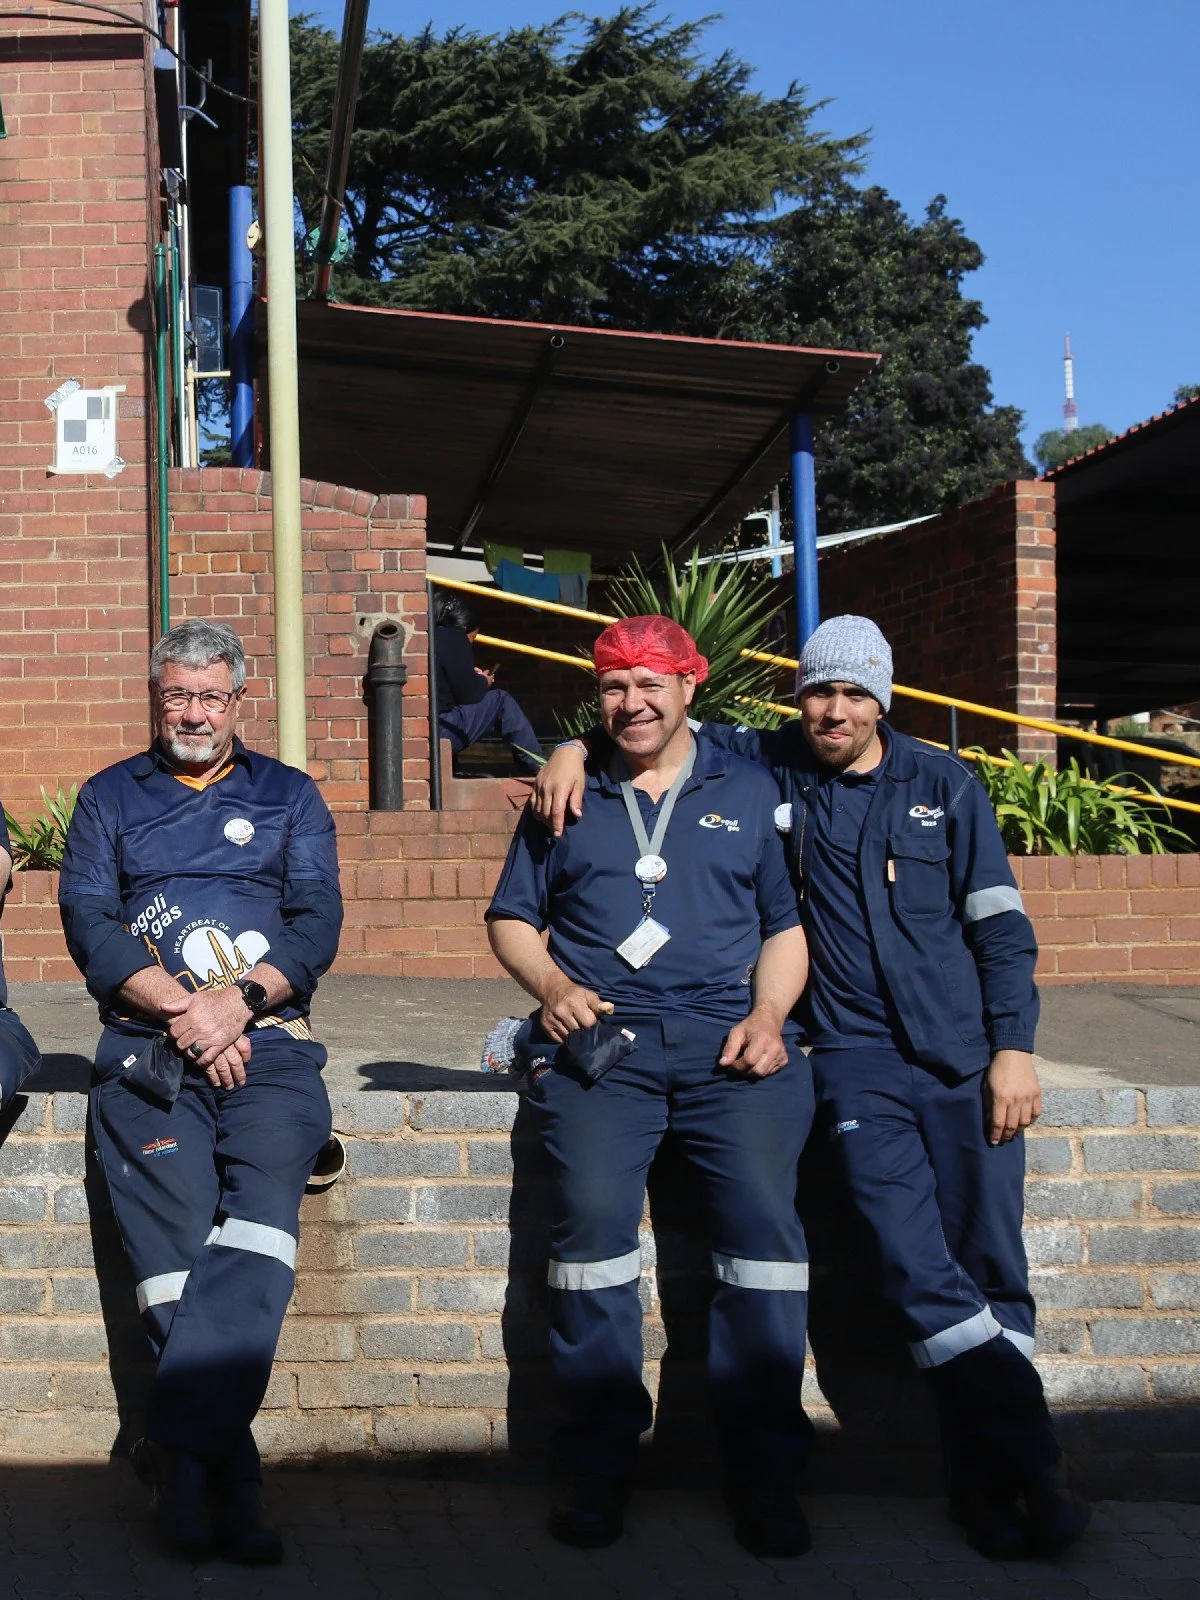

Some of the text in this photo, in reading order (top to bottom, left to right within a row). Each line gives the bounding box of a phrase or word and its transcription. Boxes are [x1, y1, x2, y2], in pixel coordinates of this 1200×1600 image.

[72, 445, 98, 455] A016
[130, 892, 167, 937] egoli
[151, 905, 182, 940] gas
[174, 918, 231, 954] HEARTBEAT OF
